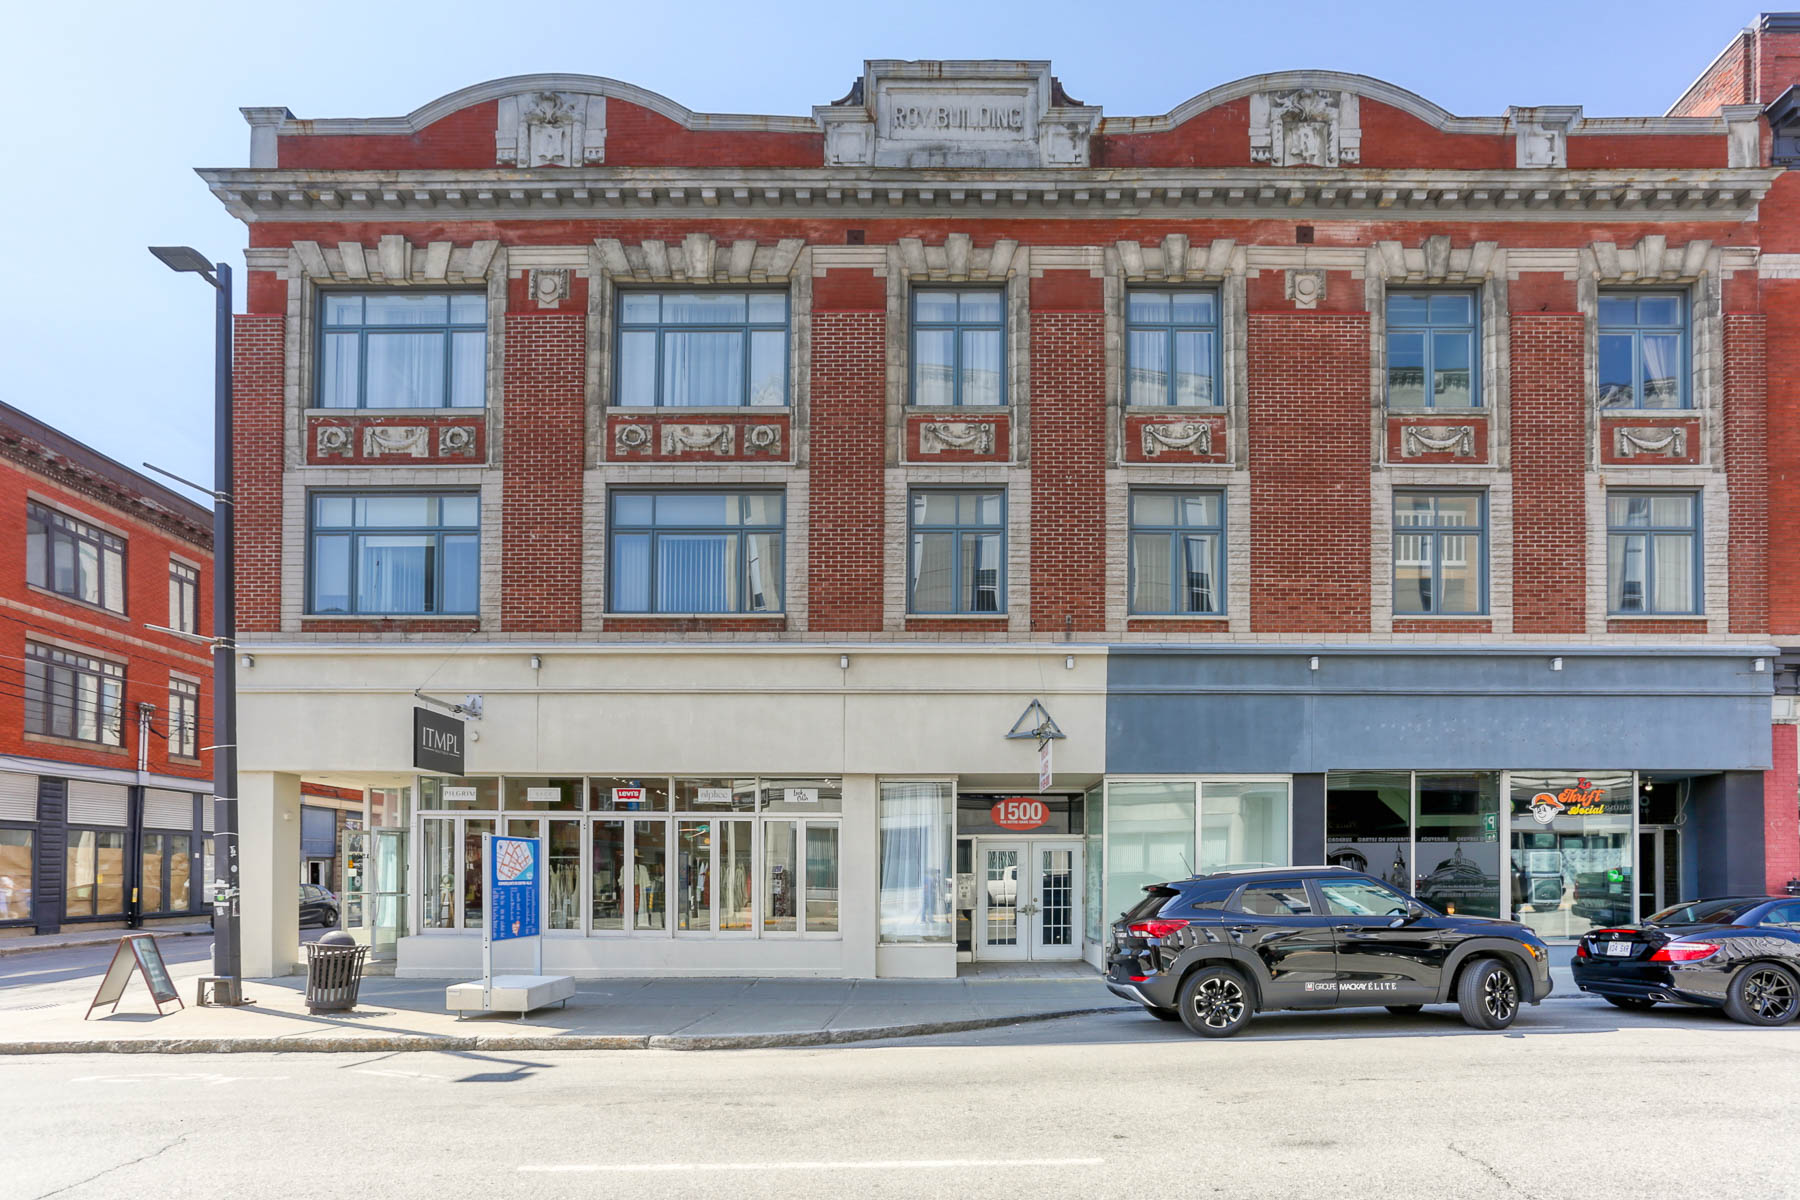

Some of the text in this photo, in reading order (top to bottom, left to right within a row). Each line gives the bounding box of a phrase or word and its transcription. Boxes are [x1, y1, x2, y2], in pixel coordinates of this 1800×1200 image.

[893, 105, 1022, 128] ROY BUILDING
[422, 726, 460, 754] ITMPL
[1577, 777, 1593, 789] Le
[1557, 788, 1606, 806] Thrift
[996, 802, 1043, 820] 1500
[1567, 804, 1605, 815] Social
[1314, 983, 1337, 991] GROUPE
[1339, 983, 1367, 991] MACKAY
[1367, 982, 1397, 991] ÉLITE
